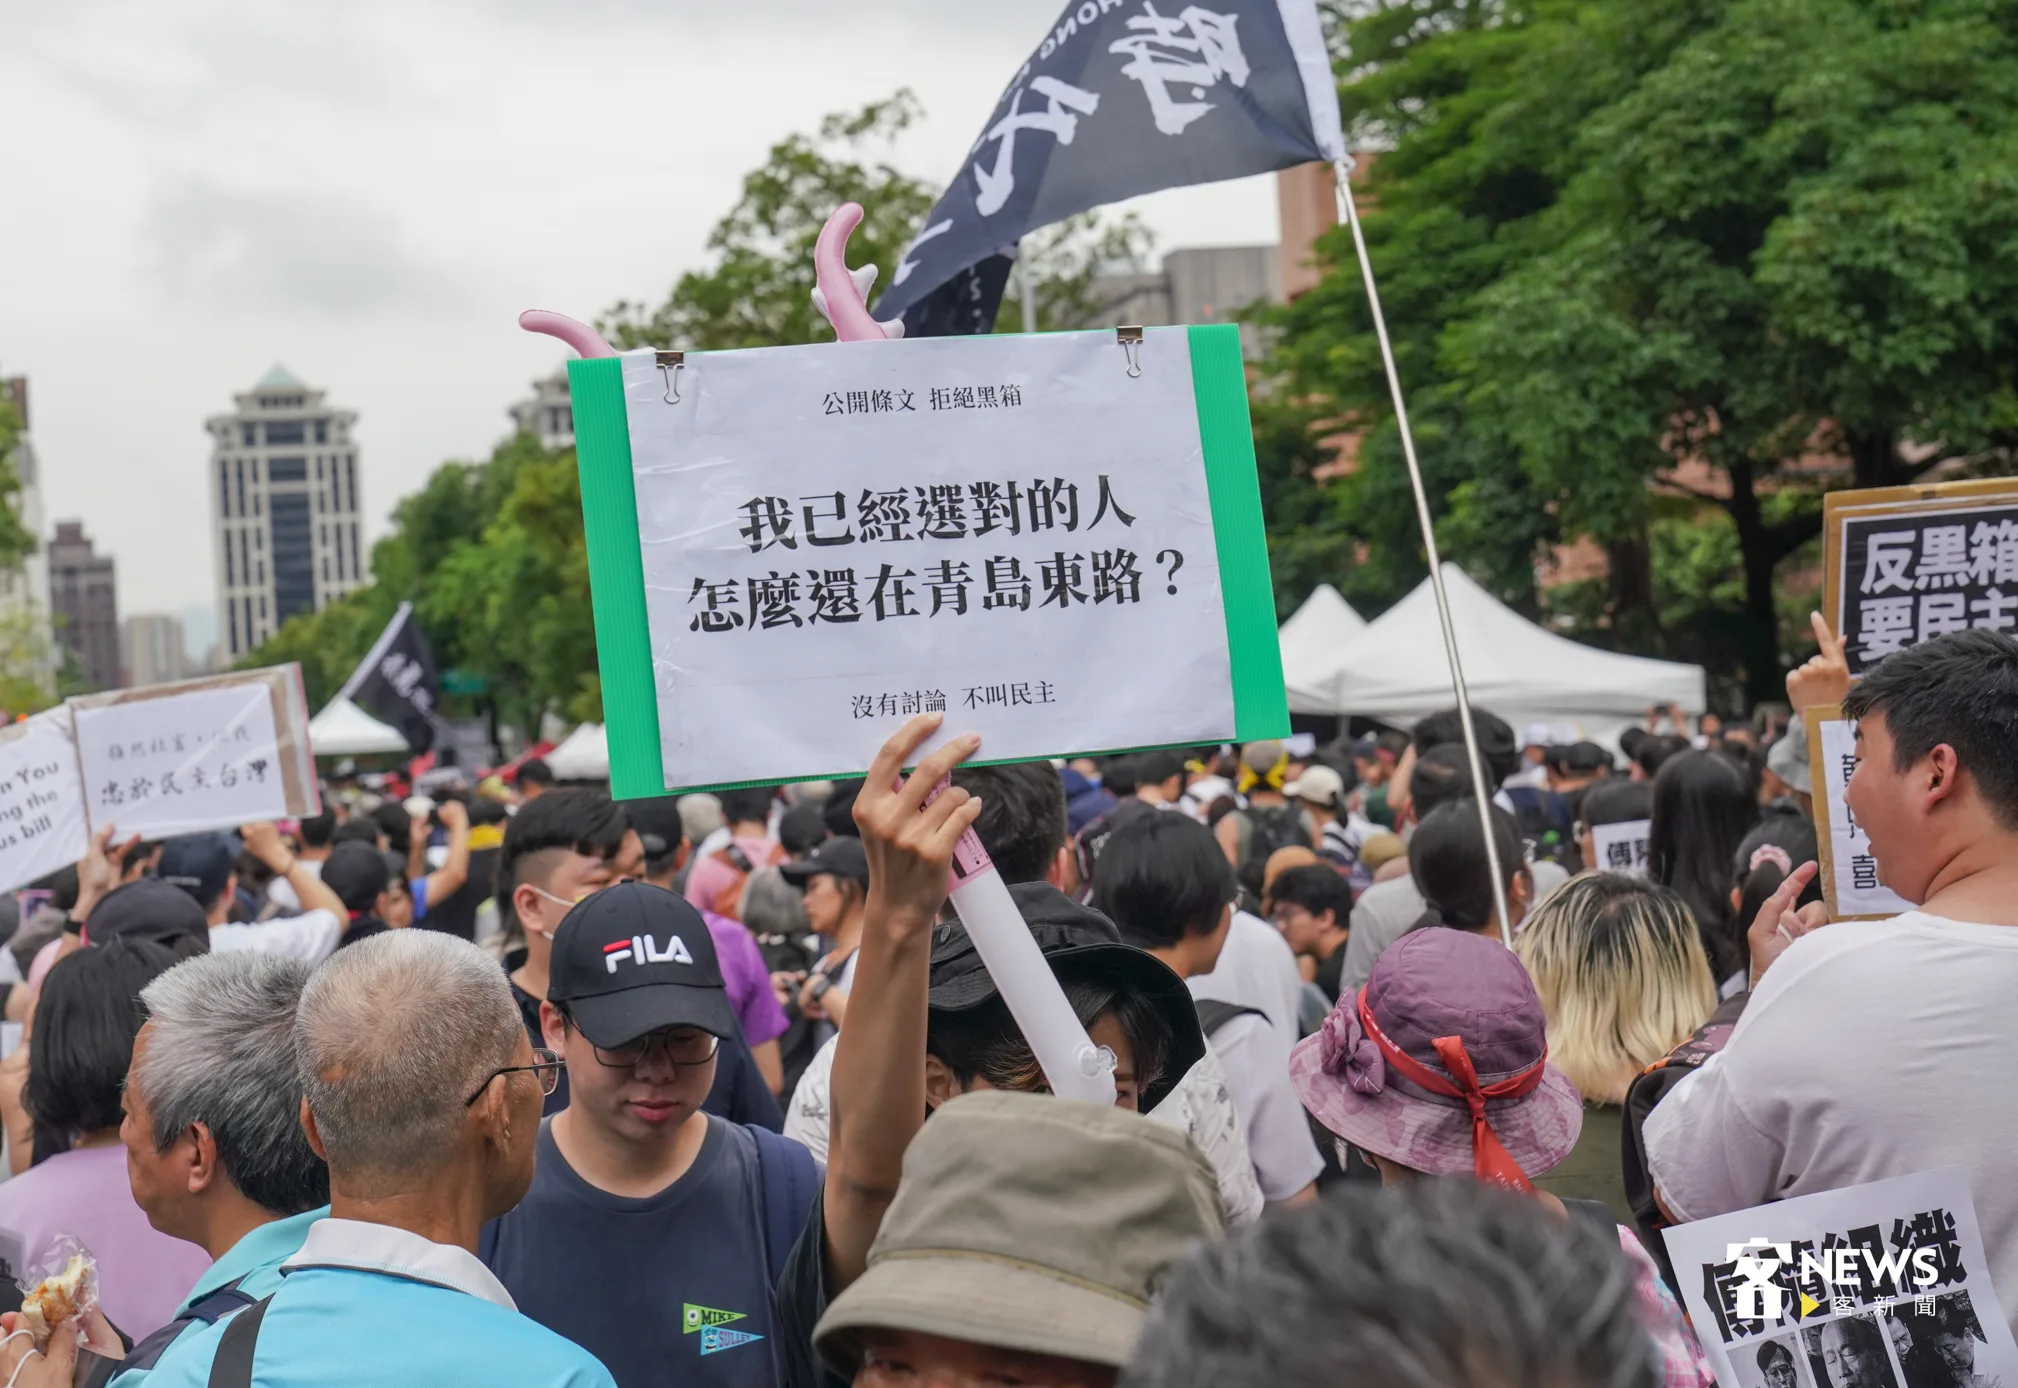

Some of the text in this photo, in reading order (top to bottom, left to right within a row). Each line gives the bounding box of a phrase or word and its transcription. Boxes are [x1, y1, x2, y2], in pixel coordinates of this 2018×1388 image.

[821, 383, 1023, 416] 公開條文 拒絕黑箱
[736, 474, 1137, 553] 我已經選對的人
[1859, 519, 2018, 594] 反黑箱
[687, 548, 1186, 633] 怎麼還在青島東路？
[851, 681, 1057, 719] 沒有討論 不叫民主
[16, 761, 58, 784] You
[26, 792, 58, 810] the
[20, 814, 52, 839] bill
[602, 934, 694, 975] FILA
[701, 1309, 736, 1325] MIKE
[718, 1330, 752, 1349] SULLEY
